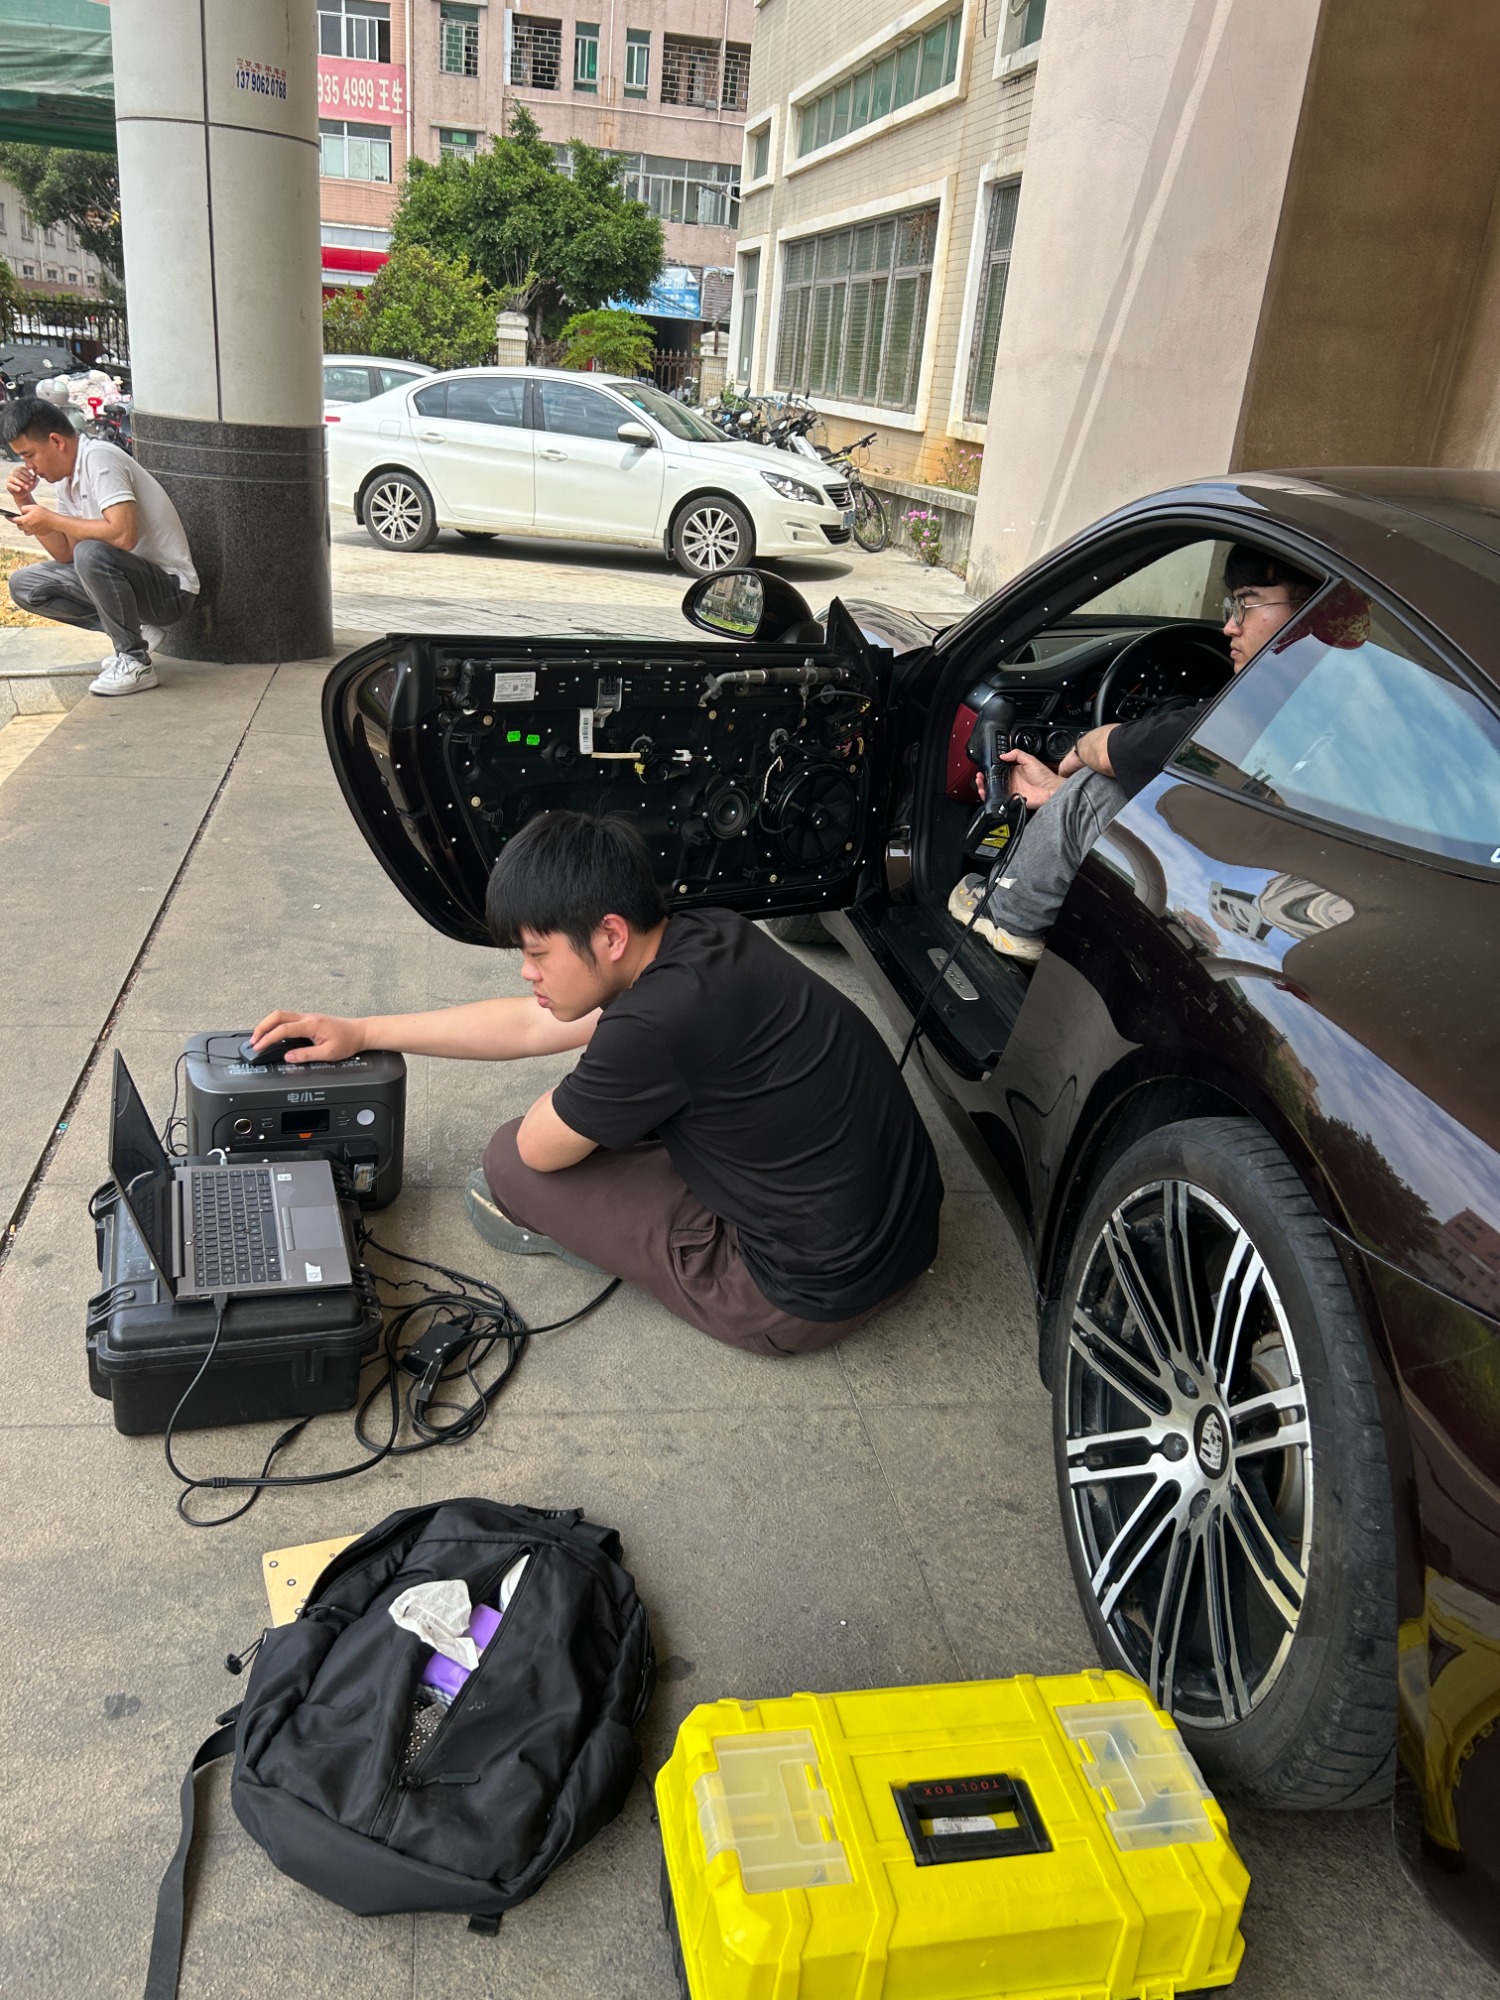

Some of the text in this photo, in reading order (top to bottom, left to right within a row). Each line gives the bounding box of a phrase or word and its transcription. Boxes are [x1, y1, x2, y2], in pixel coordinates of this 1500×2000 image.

[236, 69, 250, 90] 137
[343, 77, 374, 108] 4999
[378, 78, 404, 114] 王生
[287, 1091, 325, 1103] 电小二
[924, 1779, 1000, 1796] TOOL BOX
